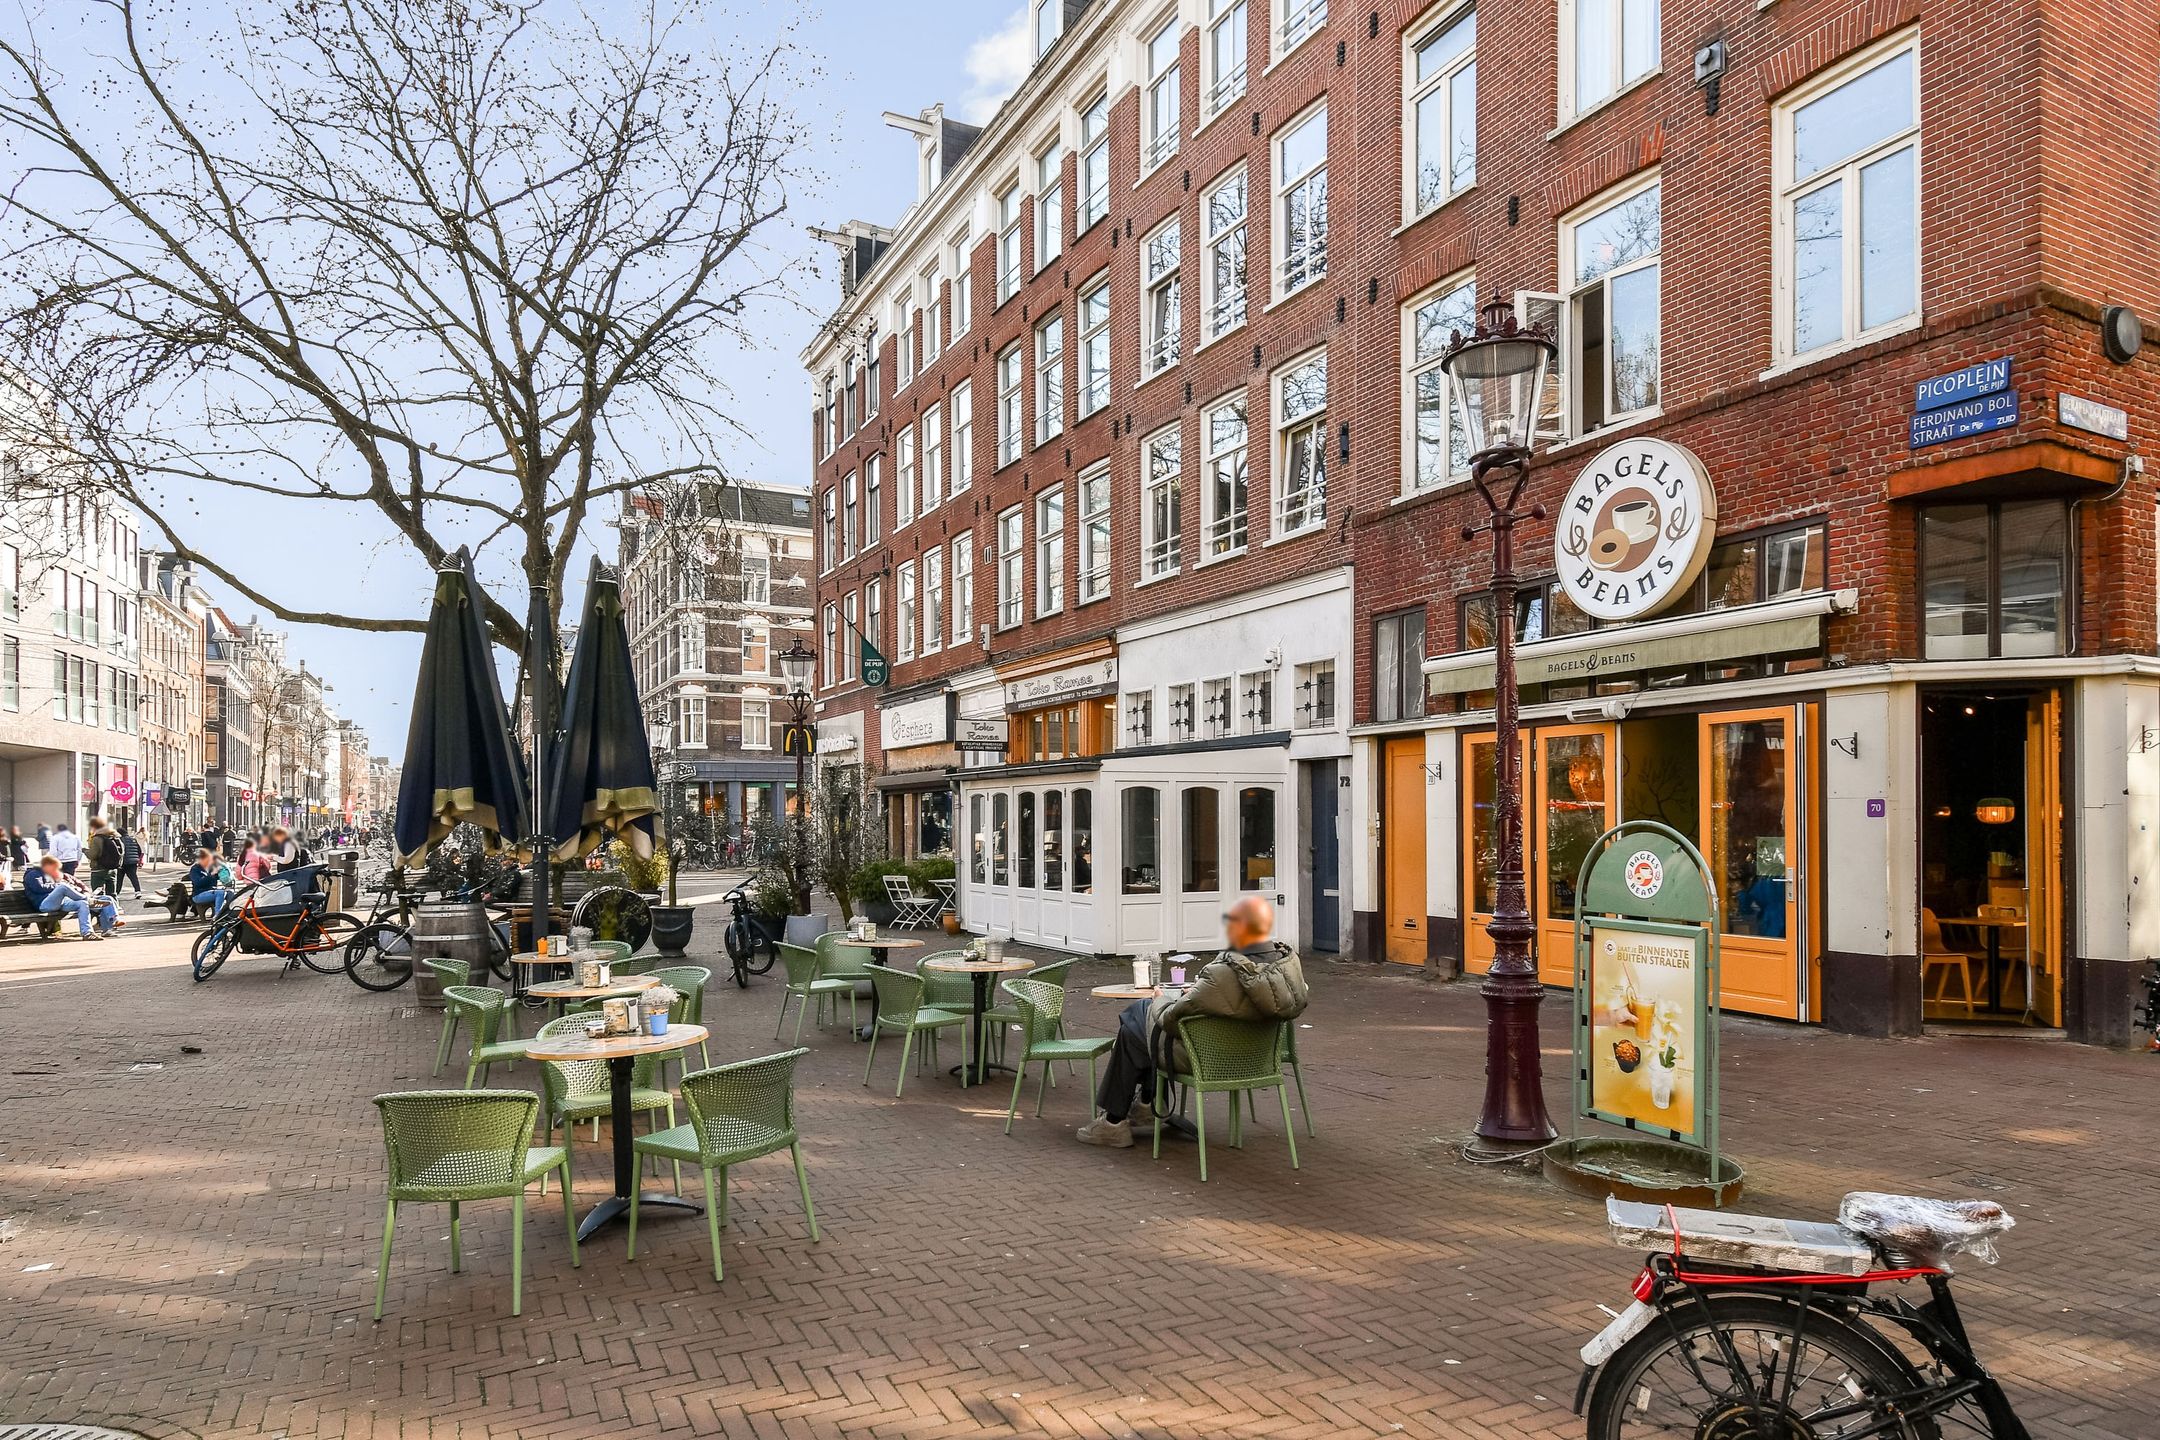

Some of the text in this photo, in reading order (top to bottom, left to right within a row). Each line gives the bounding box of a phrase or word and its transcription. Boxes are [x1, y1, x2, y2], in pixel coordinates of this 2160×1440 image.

[1918, 361, 2005, 401] PICOPLEIN
[1978, 380, 2005, 393] DE PIJP
[1913, 396, 2013, 430] FERDINAND BOL
[1913, 423, 1955, 445] STRAAT
[1960, 424, 1970, 432] De
[1996, 414, 2017, 425] ZUID
[1575, 453, 1684, 516] BAGELS
[1575, 555, 1674, 605] BEANS
[1547, 659, 1585, 673] BAGELS
[1601, 652, 1636, 666] BEANS
[1024, 674, 1094, 697] Toko Ramee
[971, 721, 995, 732] Toko
[1339, 775, 1351, 788] 72
[1870, 803, 1881, 812] 70
[1629, 853, 1659, 869] BAGELS
[1630, 882, 1658, 896] BEANS
[1638, 944, 1690, 959] BINNENSTE
[1617, 952, 1690, 969] BUITEN STRALEN
